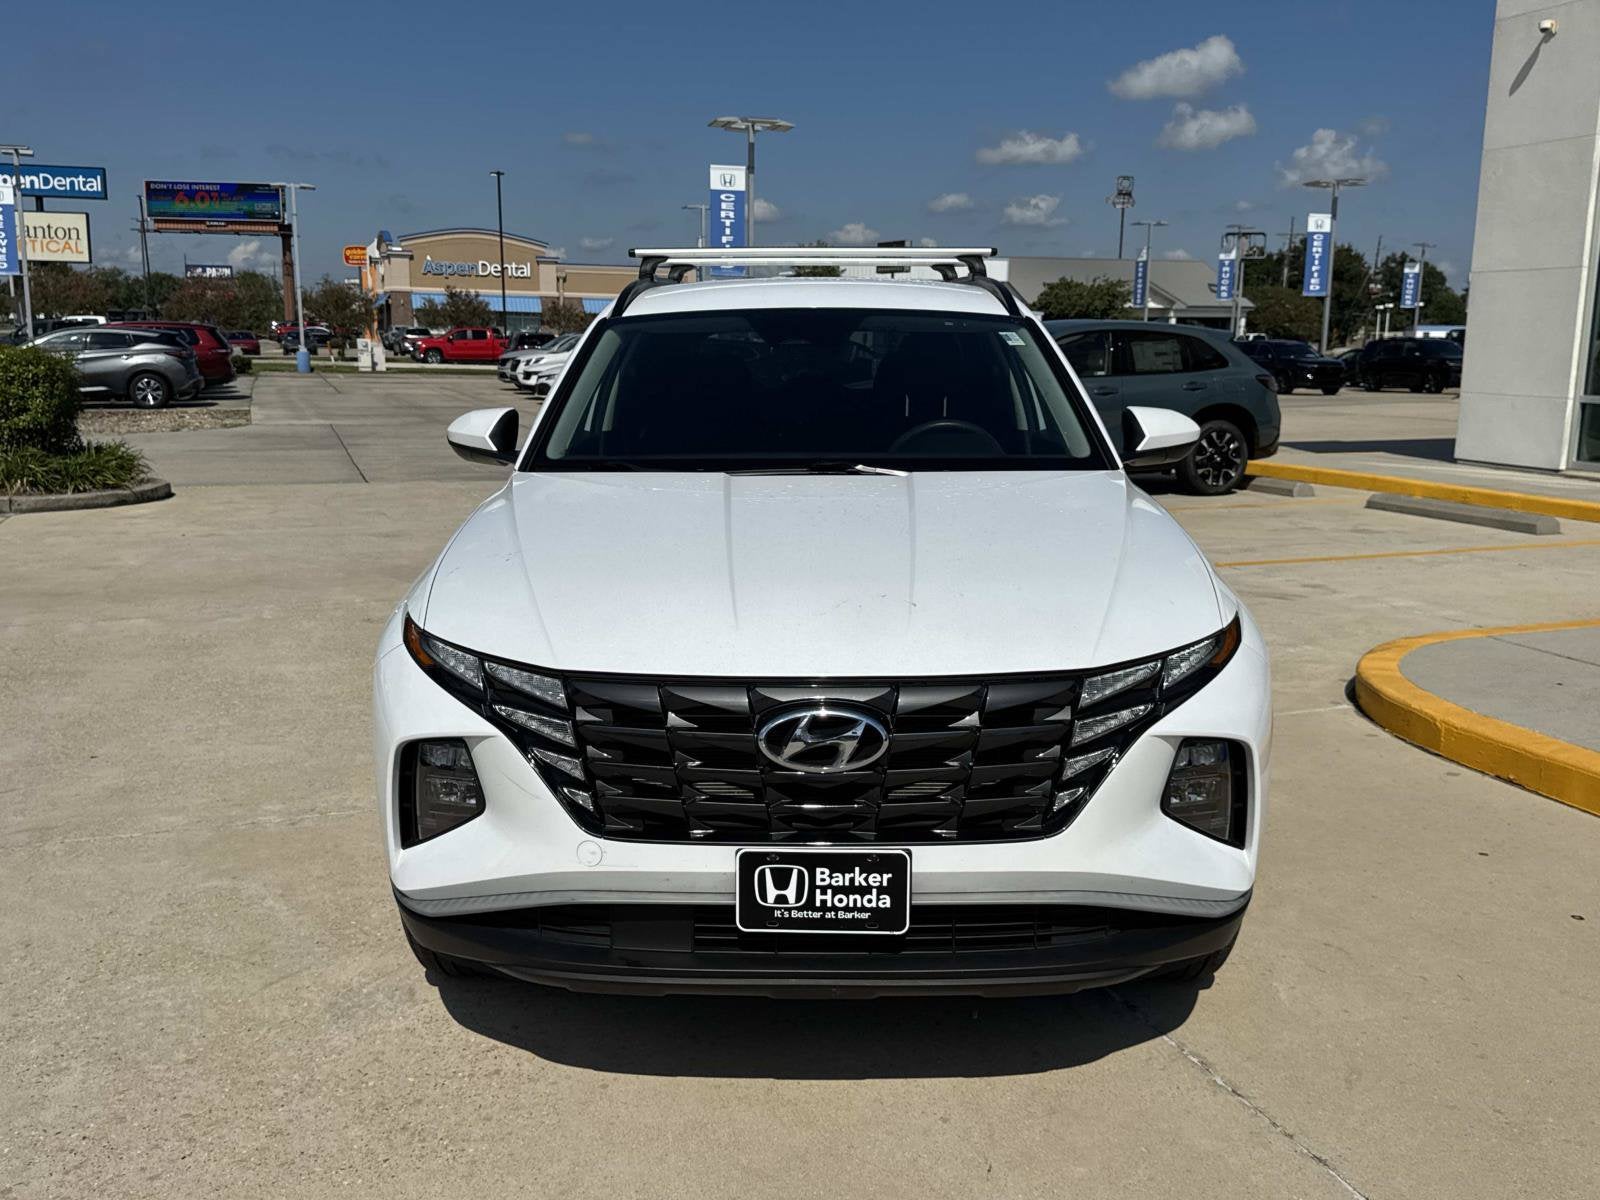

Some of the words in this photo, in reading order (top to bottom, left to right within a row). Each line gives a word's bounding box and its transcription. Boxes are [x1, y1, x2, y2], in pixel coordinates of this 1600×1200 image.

[16, 223, 80, 240] anton
[1309, 234, 1324, 291] CERTIFIED
[815, 866, 892, 887] Barker
[815, 888, 891, 908] Honda
[774, 909, 789, 918] It's
[791, 909, 823, 919] Better
[825, 911, 836, 919] at
[838, 911, 871, 919] Barker
